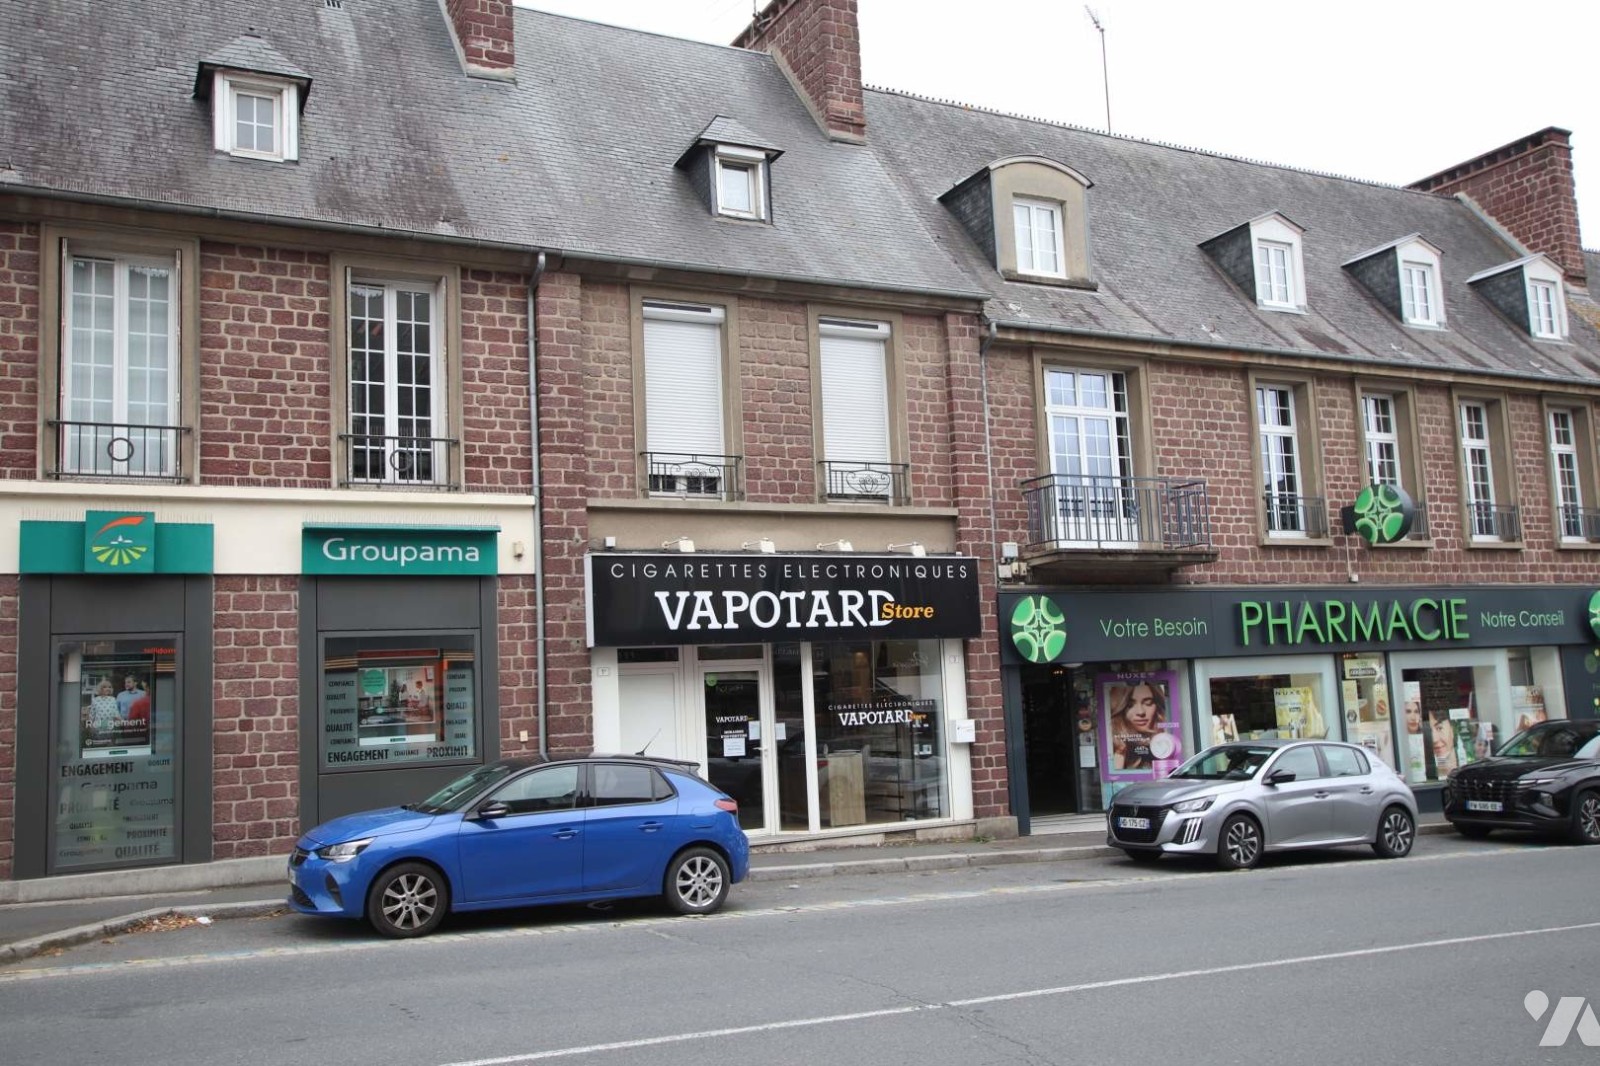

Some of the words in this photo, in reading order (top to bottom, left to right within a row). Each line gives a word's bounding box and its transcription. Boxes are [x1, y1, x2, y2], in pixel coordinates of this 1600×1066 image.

[322, 537, 480, 566] Groupama
[610, 563, 767, 579] CIGARETTES
[784, 564, 967, 579] ELECTRONIQUES
[654, 590, 895, 630] VAPOTARD
[881, 602, 935, 619] Store
[1241, 598, 1469, 645] PHARMACIE
[1480, 612, 1516, 628] Notre
[1519, 610, 1565, 627] Conseil
[1100, 618, 1149, 638] Votre
[1154, 617, 1208, 637] Besoin
[828, 703, 873, 711] CIGARETTES
[715, 715, 748, 723] VAPOTARD
[838, 710, 914, 726] VAPOTARD
[328, 749, 389, 763] ENGAGEMENT
[61, 761, 134, 777] ENGAGEMENT
[126, 826, 168, 839] PROXIMITÉ
[114, 839, 160, 859] QUALITÉ
